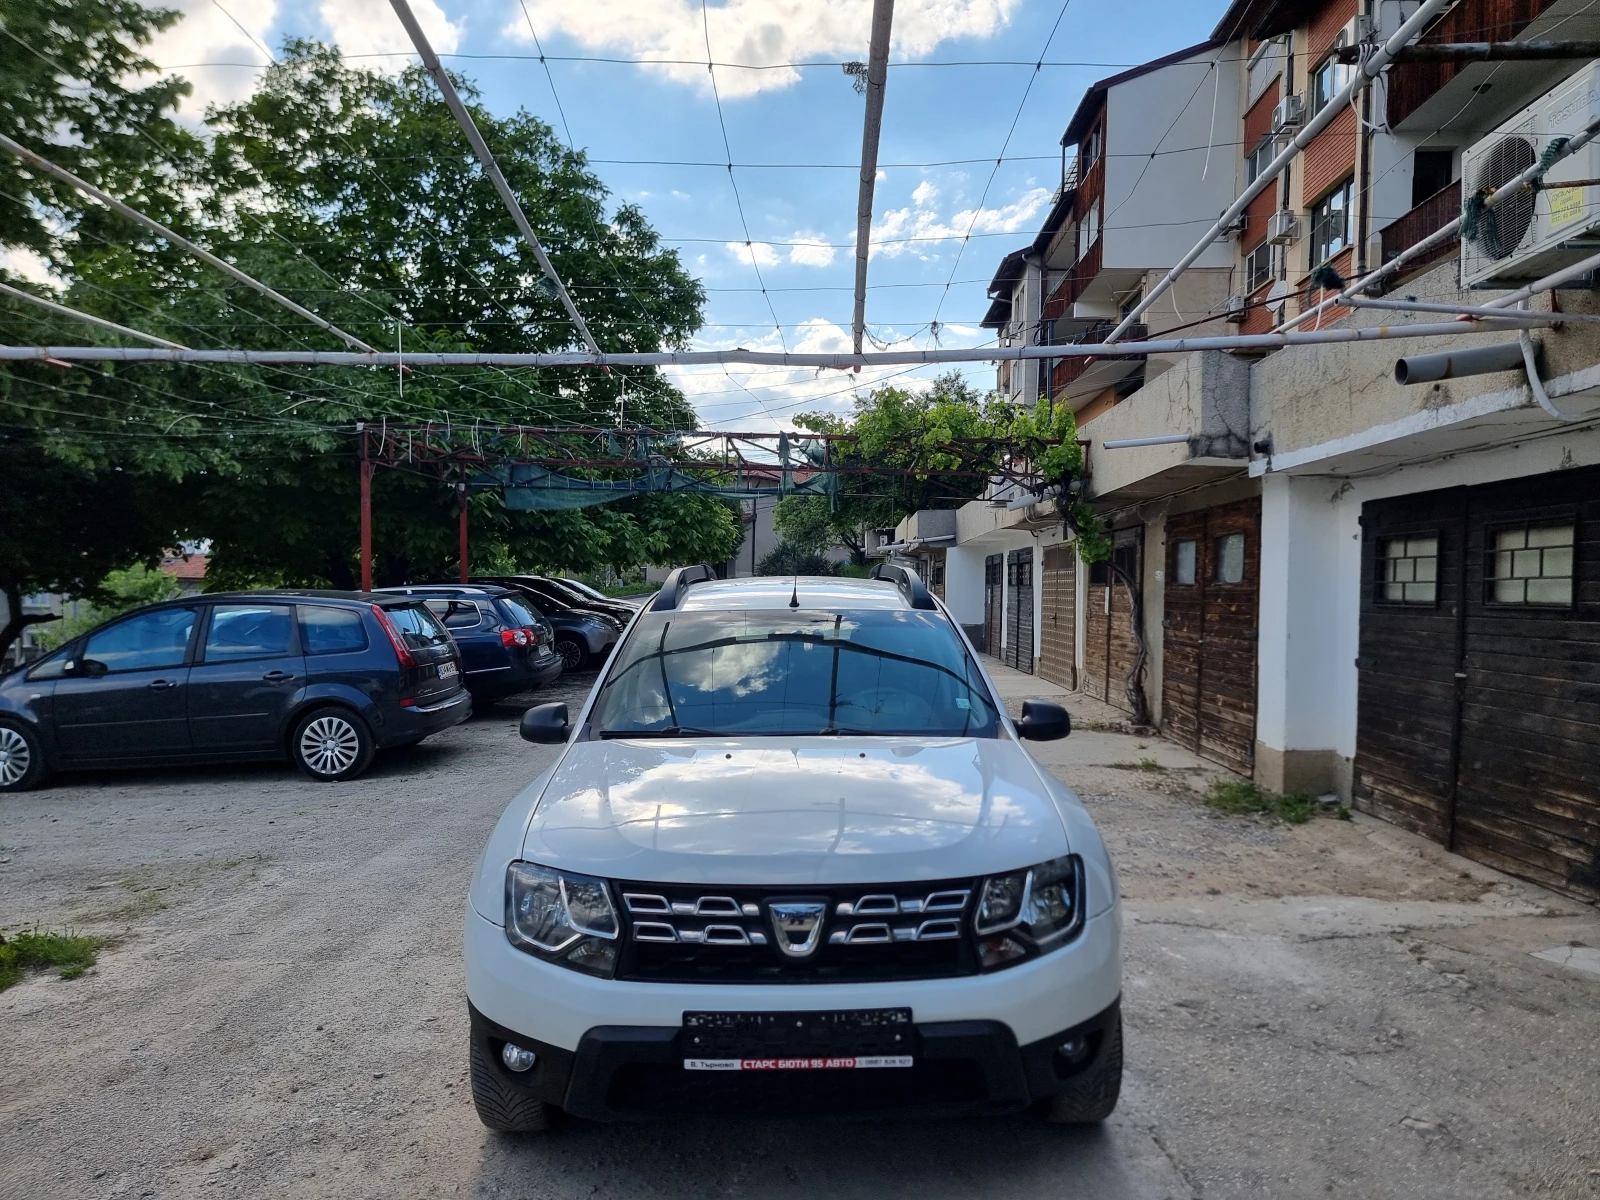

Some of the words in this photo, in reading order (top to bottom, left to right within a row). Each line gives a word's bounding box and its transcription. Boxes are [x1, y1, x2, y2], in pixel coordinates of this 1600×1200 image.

[1549, 89, 1600, 128] TOSHIBA
[743, 1060, 777, 1069] СТАРС
[778, 1060, 808, 1069] БЮТИ
[810, 1059, 824, 1069] 95
[825, 1058, 854, 1068] АВТО
